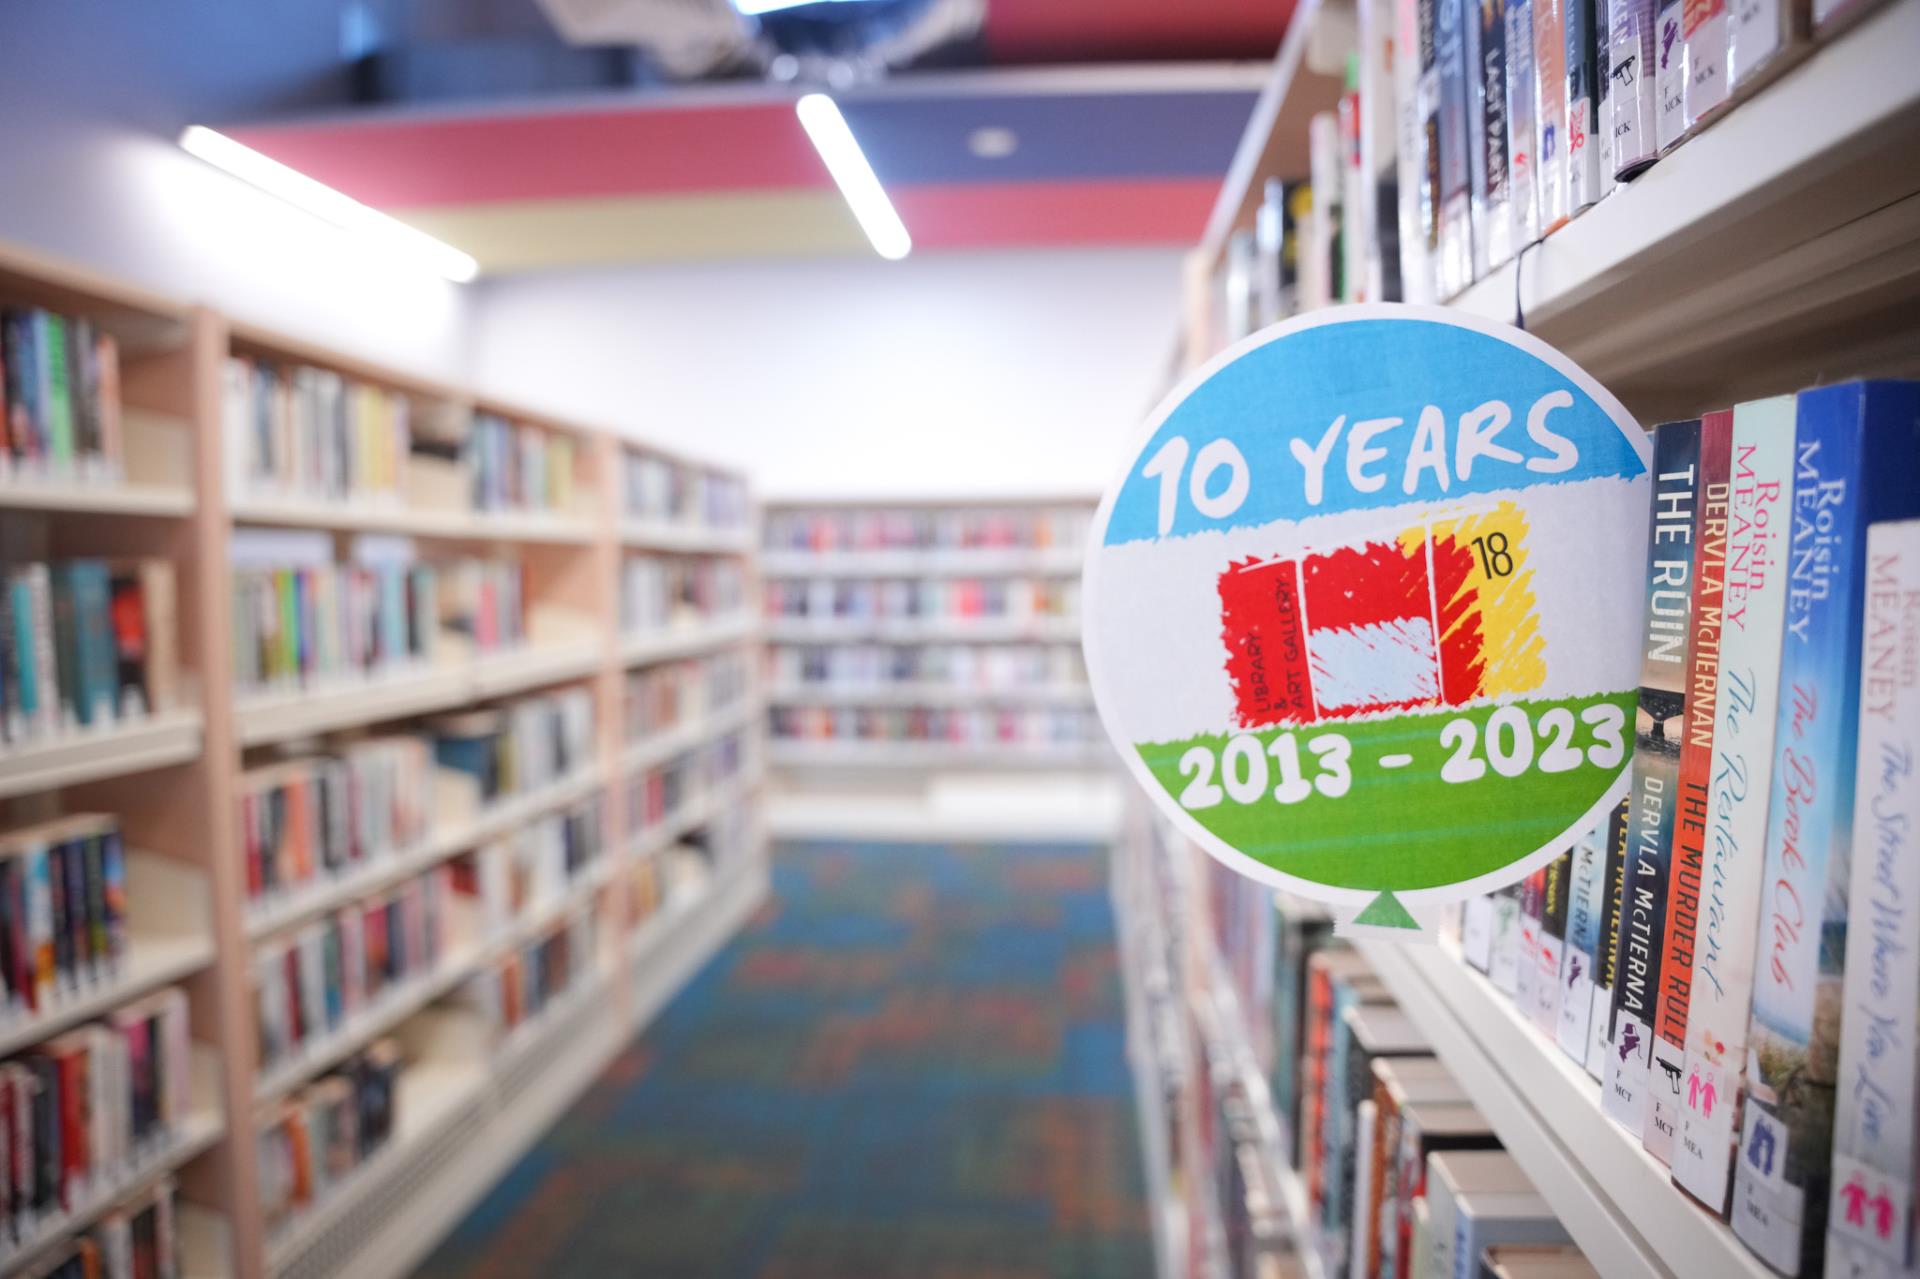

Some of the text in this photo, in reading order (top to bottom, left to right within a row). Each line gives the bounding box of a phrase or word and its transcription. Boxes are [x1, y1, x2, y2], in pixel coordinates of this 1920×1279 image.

[1142, 390, 1579, 537] 10 YEARS
[1655, 464, 1694, 545] THE
[1471, 532, 1514, 580] 18
[1727, 445, 1757, 631] MEANEY
[1750, 480, 1781, 591] Roisin
[1787, 440, 1821, 643] MEANEY
[1812, 478, 1846, 599] Roisin
[1248, 633, 1271, 713] LIBRARY
[1276, 579, 1305, 709] ART GALLERY
[1690, 482, 1729, 748] DERVLA McTIERNAN
[1867, 553, 1902, 724] MEANEY
[1178, 703, 1625, 810] 2013 - 2023
[1572, 846, 1594, 944] McTIERN
[1623, 775, 1663, 1014] DERVLA McTIERNA
[1701, 667, 1756, 1002] The Restaurant
[1771, 684, 1818, 992] The Book Club
[1663, 782, 1708, 1051] THE MURDER RULE
[1615, 1083, 1632, 1102] MCT
[1655, 1116, 1674, 1137] MCT
